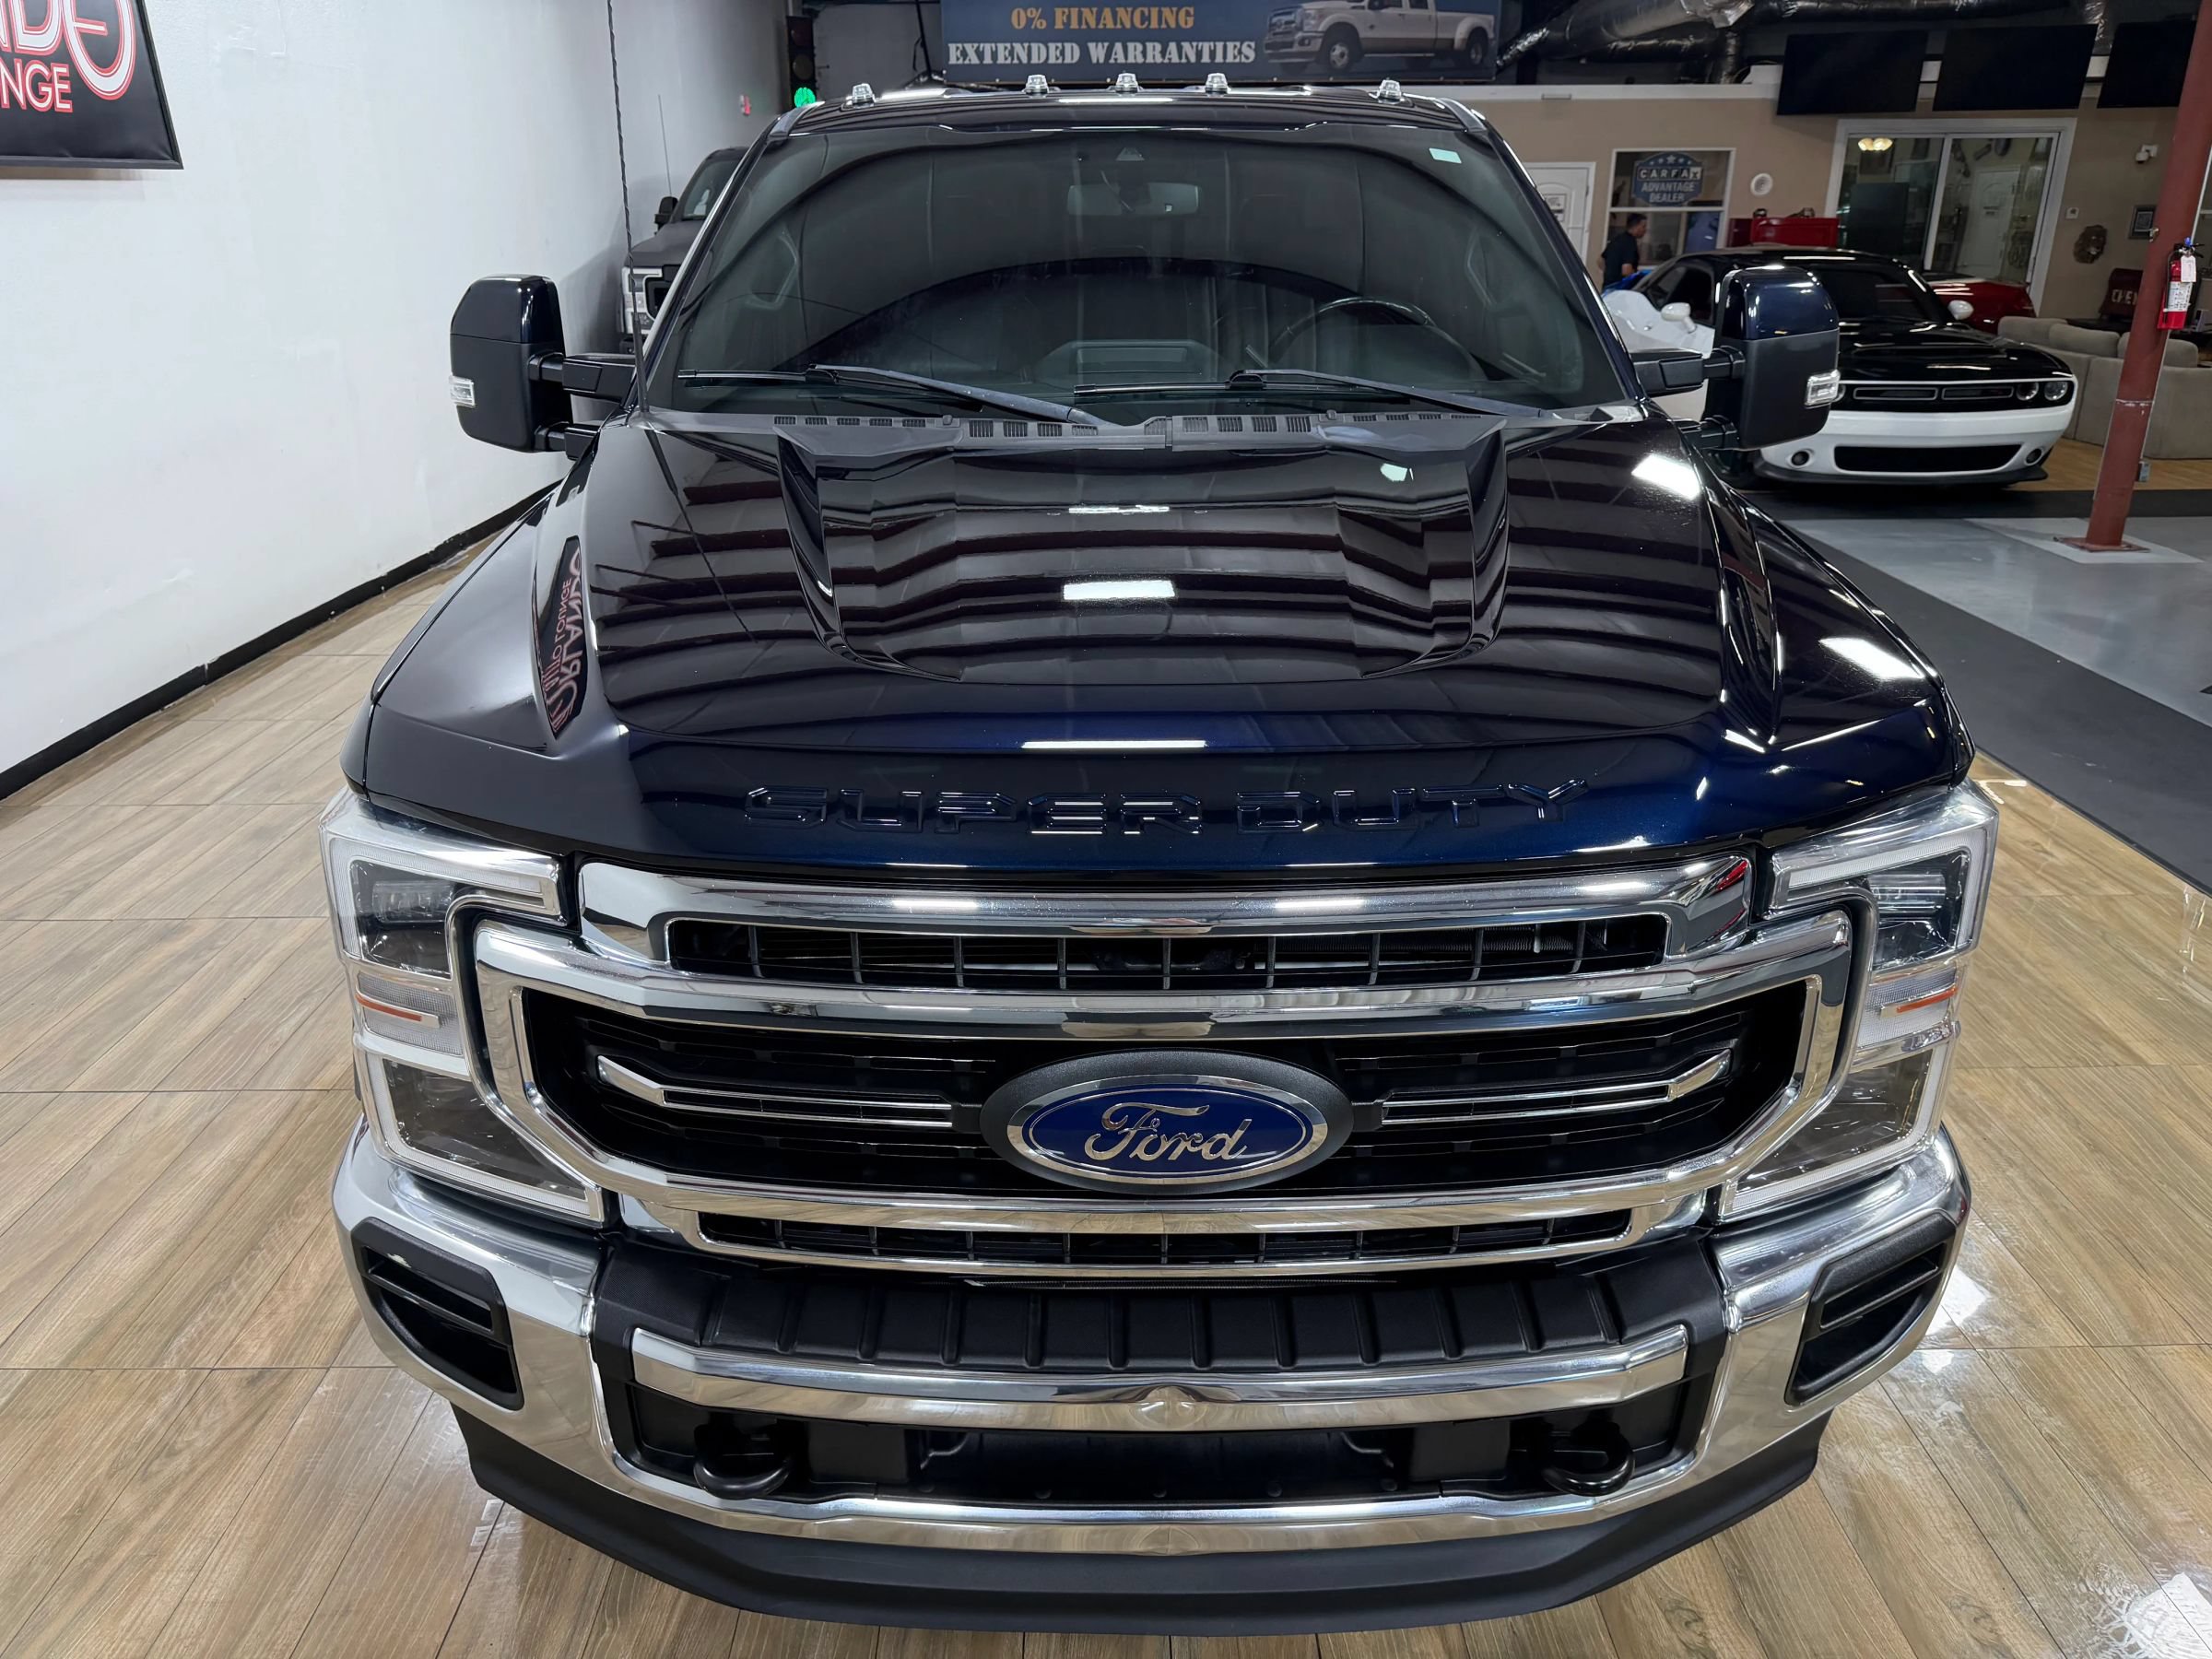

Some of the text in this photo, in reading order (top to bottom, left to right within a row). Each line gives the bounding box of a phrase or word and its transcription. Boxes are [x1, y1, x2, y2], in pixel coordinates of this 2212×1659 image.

[1011, 6, 1195, 29] 0% FINANCING
[947, 41, 1256, 65] EXTENDED WARRANTIES
[1640, 168, 1701, 180] CARFAX
[1641, 182, 1696, 192] ADVANTAGE
[1649, 193, 1685, 203] DEALER
[745, 778, 1590, 834] SUPER DUTY
[1084, 1102, 1252, 1161] Ford
